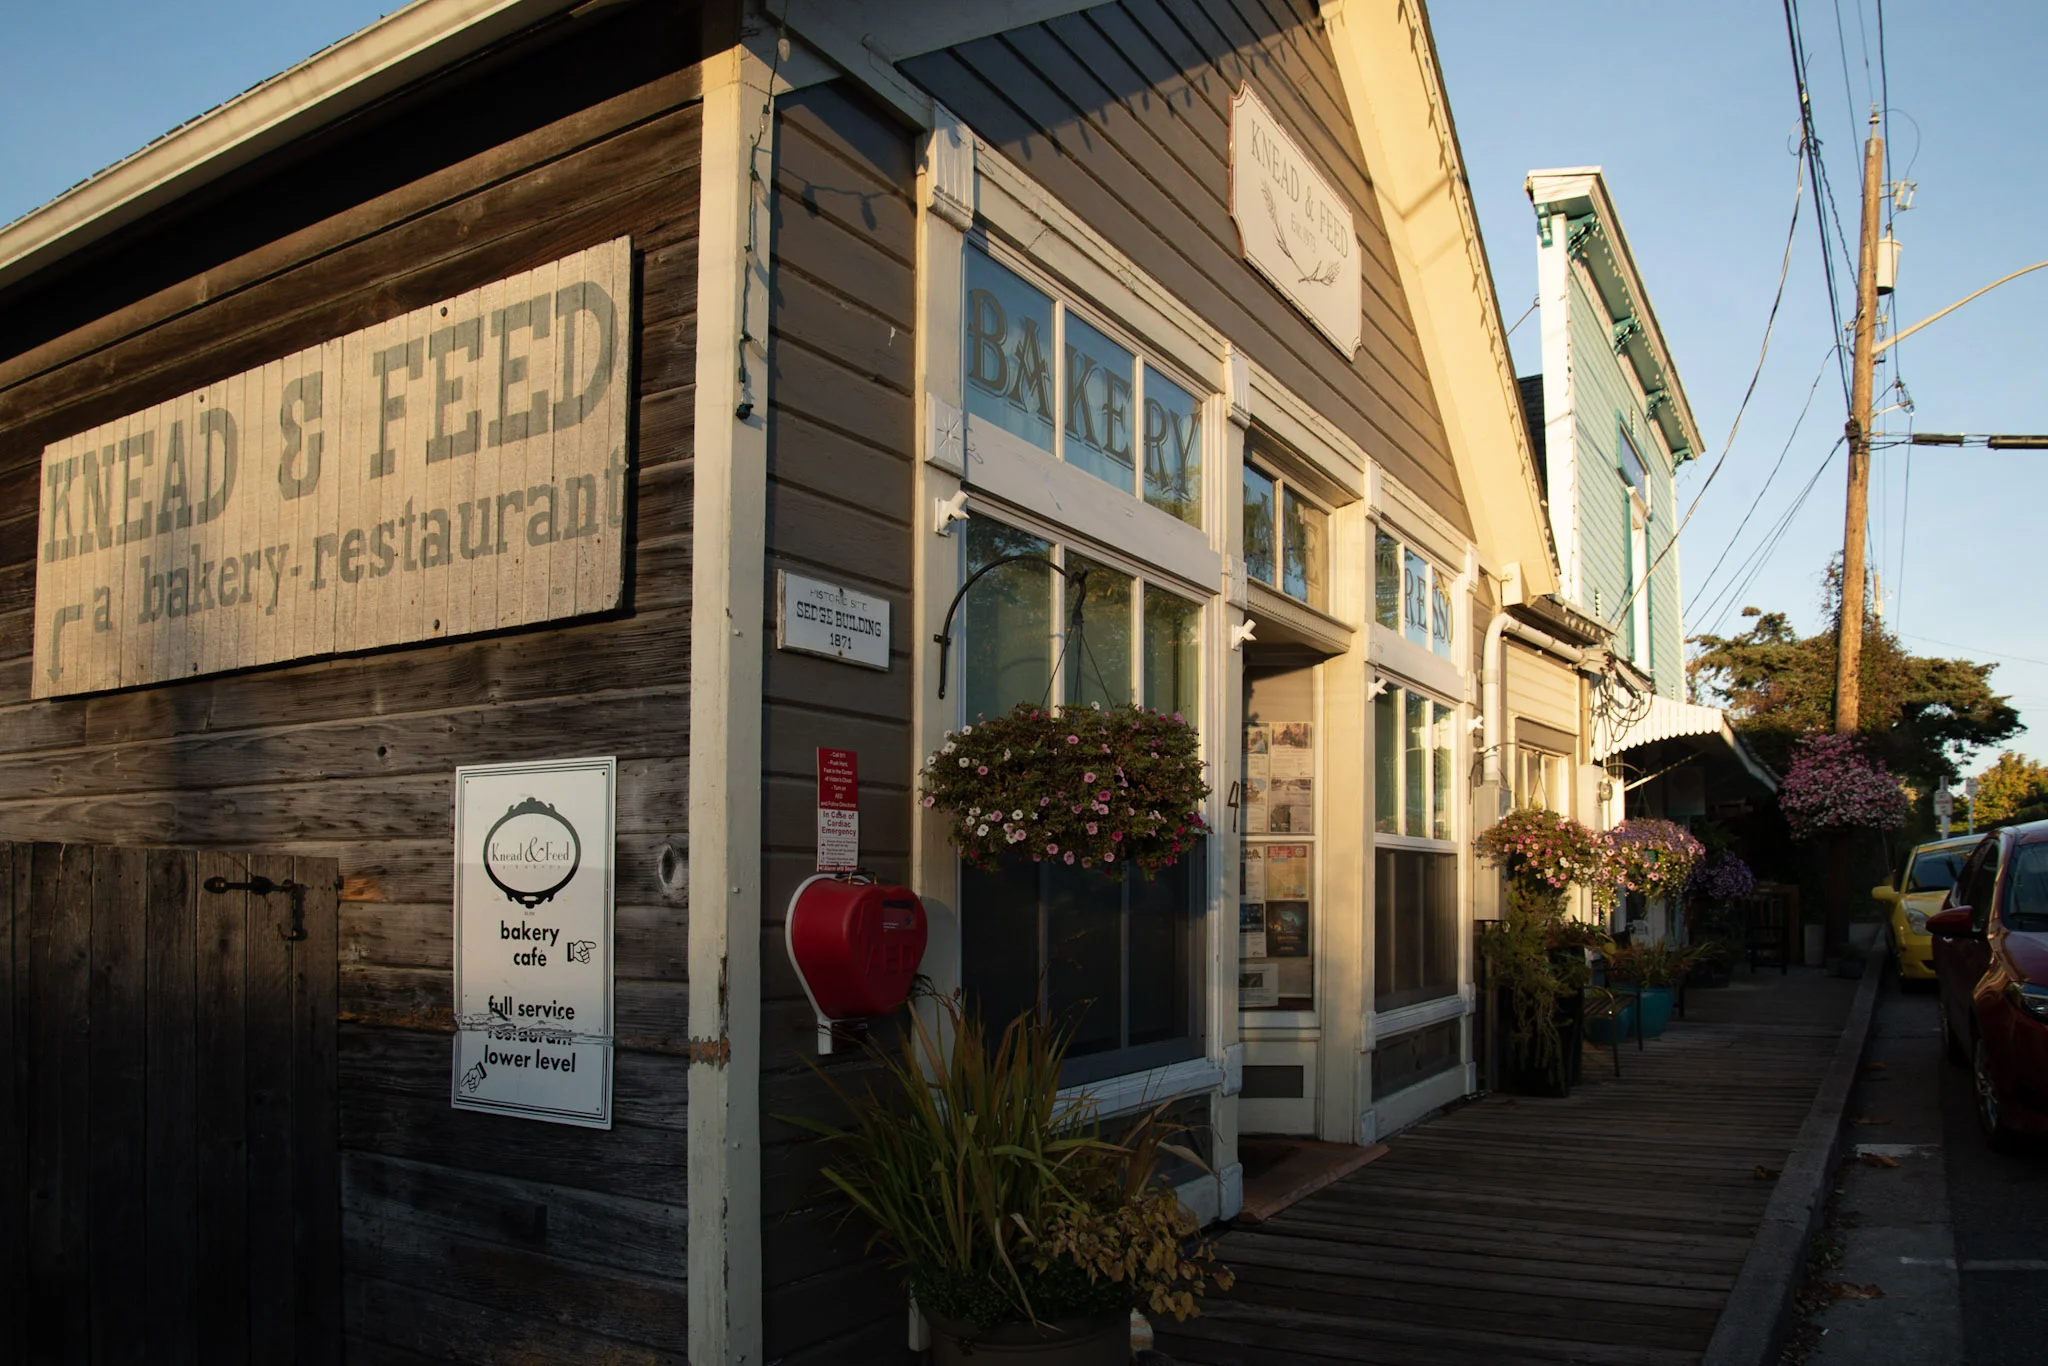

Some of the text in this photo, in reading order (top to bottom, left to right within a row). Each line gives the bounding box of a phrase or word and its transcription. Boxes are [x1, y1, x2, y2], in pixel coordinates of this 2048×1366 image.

[1251, 119, 1349, 259] KNEAD & FEED
[968, 289, 1201, 502] BAKERY
[42, 280, 619, 564] KNEAD & FEED
[93, 584, 113, 633] a
[797, 601, 881, 637] SEDGE BUILDING
[830, 632, 852, 650] 1871
[831, 811, 847, 819] Case
[1227, 780, 1240, 833] 4
[822, 827, 857, 837] Emergency
[827, 820, 851, 828] Cardiac
[492, 841, 523, 861] Knead
[546, 840, 570, 861] Feed
[500, 920, 560, 947] bakery
[513, 946, 547, 967] café
[488, 994, 575, 1021] full service
[484, 1044, 576, 1072] lower level
